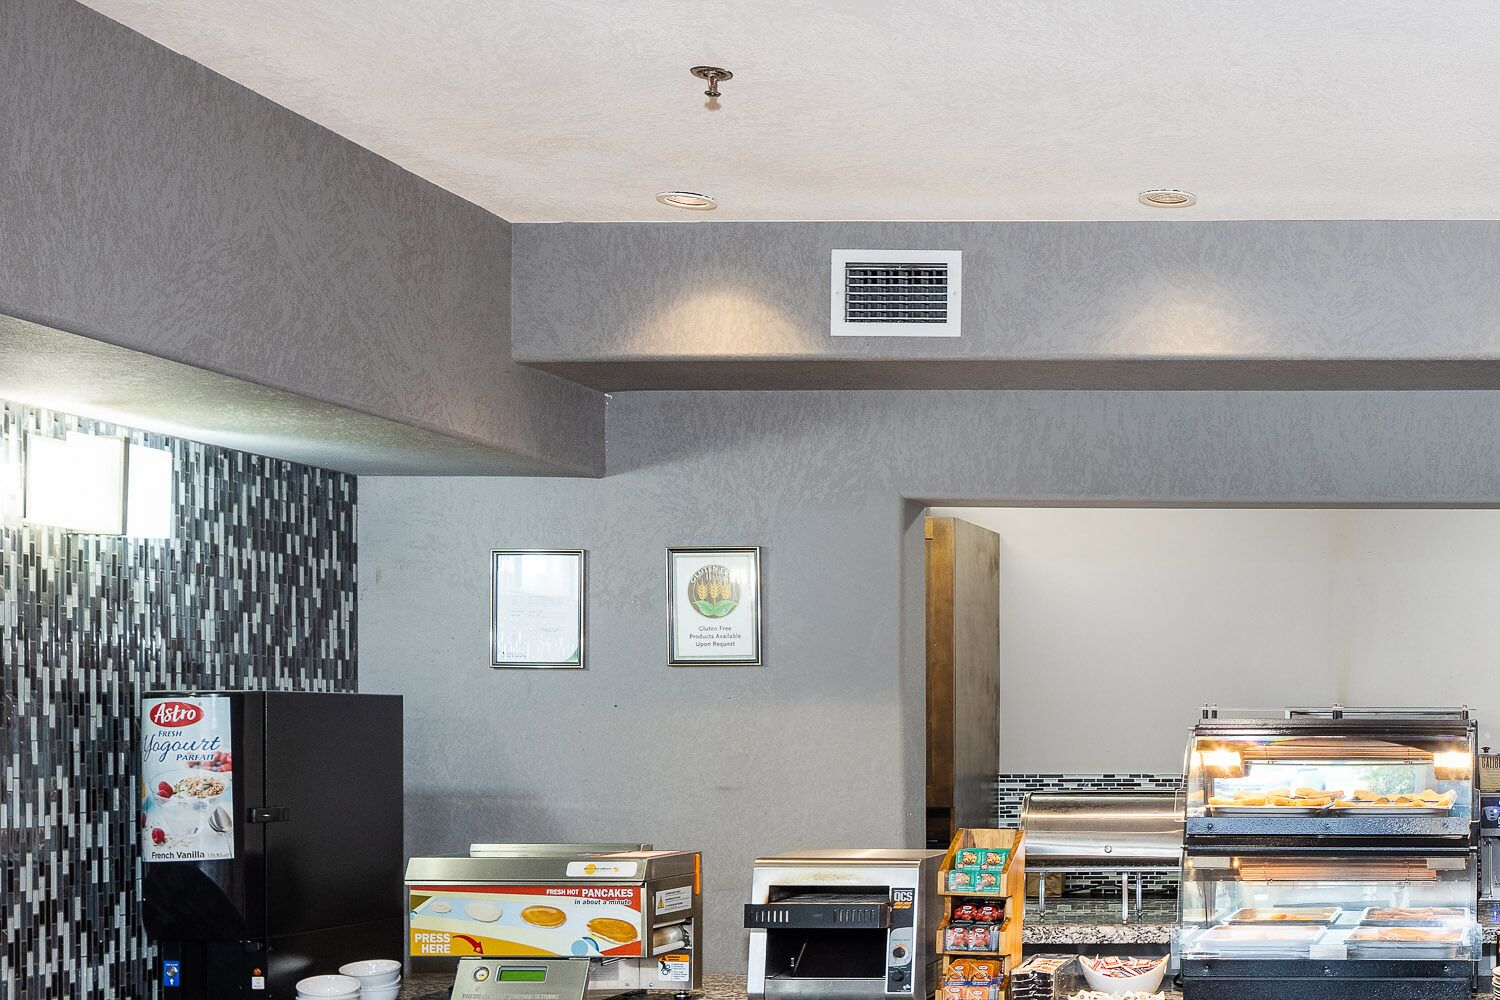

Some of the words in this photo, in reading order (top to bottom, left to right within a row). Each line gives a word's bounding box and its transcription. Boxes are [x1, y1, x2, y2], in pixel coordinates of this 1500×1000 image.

[154, 702, 197, 724] Astro
[158, 730, 183, 738] FRESH
[143, 734, 221, 762] Yogourt
[176, 753, 215, 761] PARFAIT
[151, 851, 175, 859] French
[176, 850, 205, 859] Vanilla
[545, 888, 566, 896] FRESH
[566, 888, 579, 896] HOT
[581, 888, 634, 898] PANCAKES
[414, 933, 451, 943] PRESS
[421, 943, 451, 954] HERE
